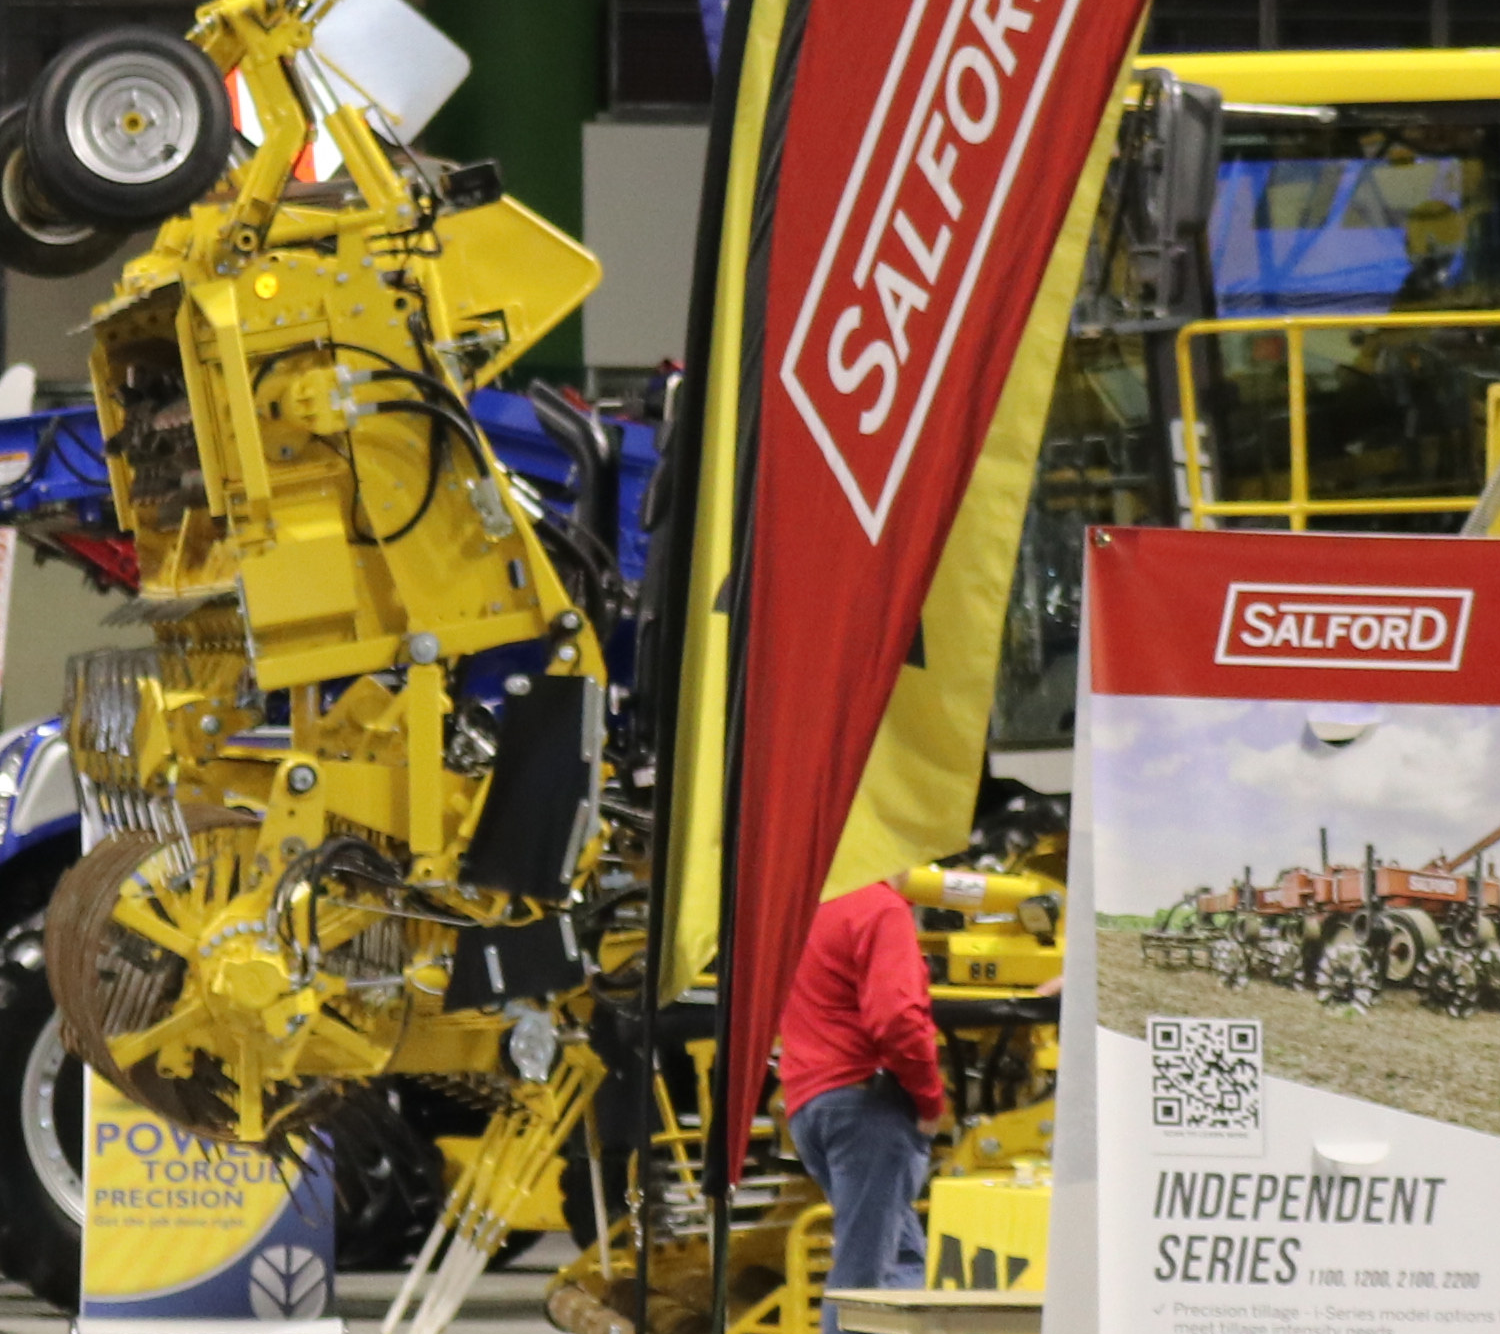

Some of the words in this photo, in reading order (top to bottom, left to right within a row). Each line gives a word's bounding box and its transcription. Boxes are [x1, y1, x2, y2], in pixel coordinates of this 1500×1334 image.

[1239, 601, 1449, 652] SALFORD
[96, 1123, 250, 1157] POW
[142, 1160, 285, 1187] TORQUE
[95, 1189, 244, 1209] PRECISION
[1153, 1171, 1447, 1225] INDEPENDENT
[1154, 1233, 1302, 1286] SERIES
[1442, 1271, 1481, 1290] 2200
[1173, 1302, 1247, 1318] Precision
[1252, 1303, 1299, 1322] tillage
[1380, 1308, 1430, 1322] model
[1434, 1308, 1495, 1325] options
